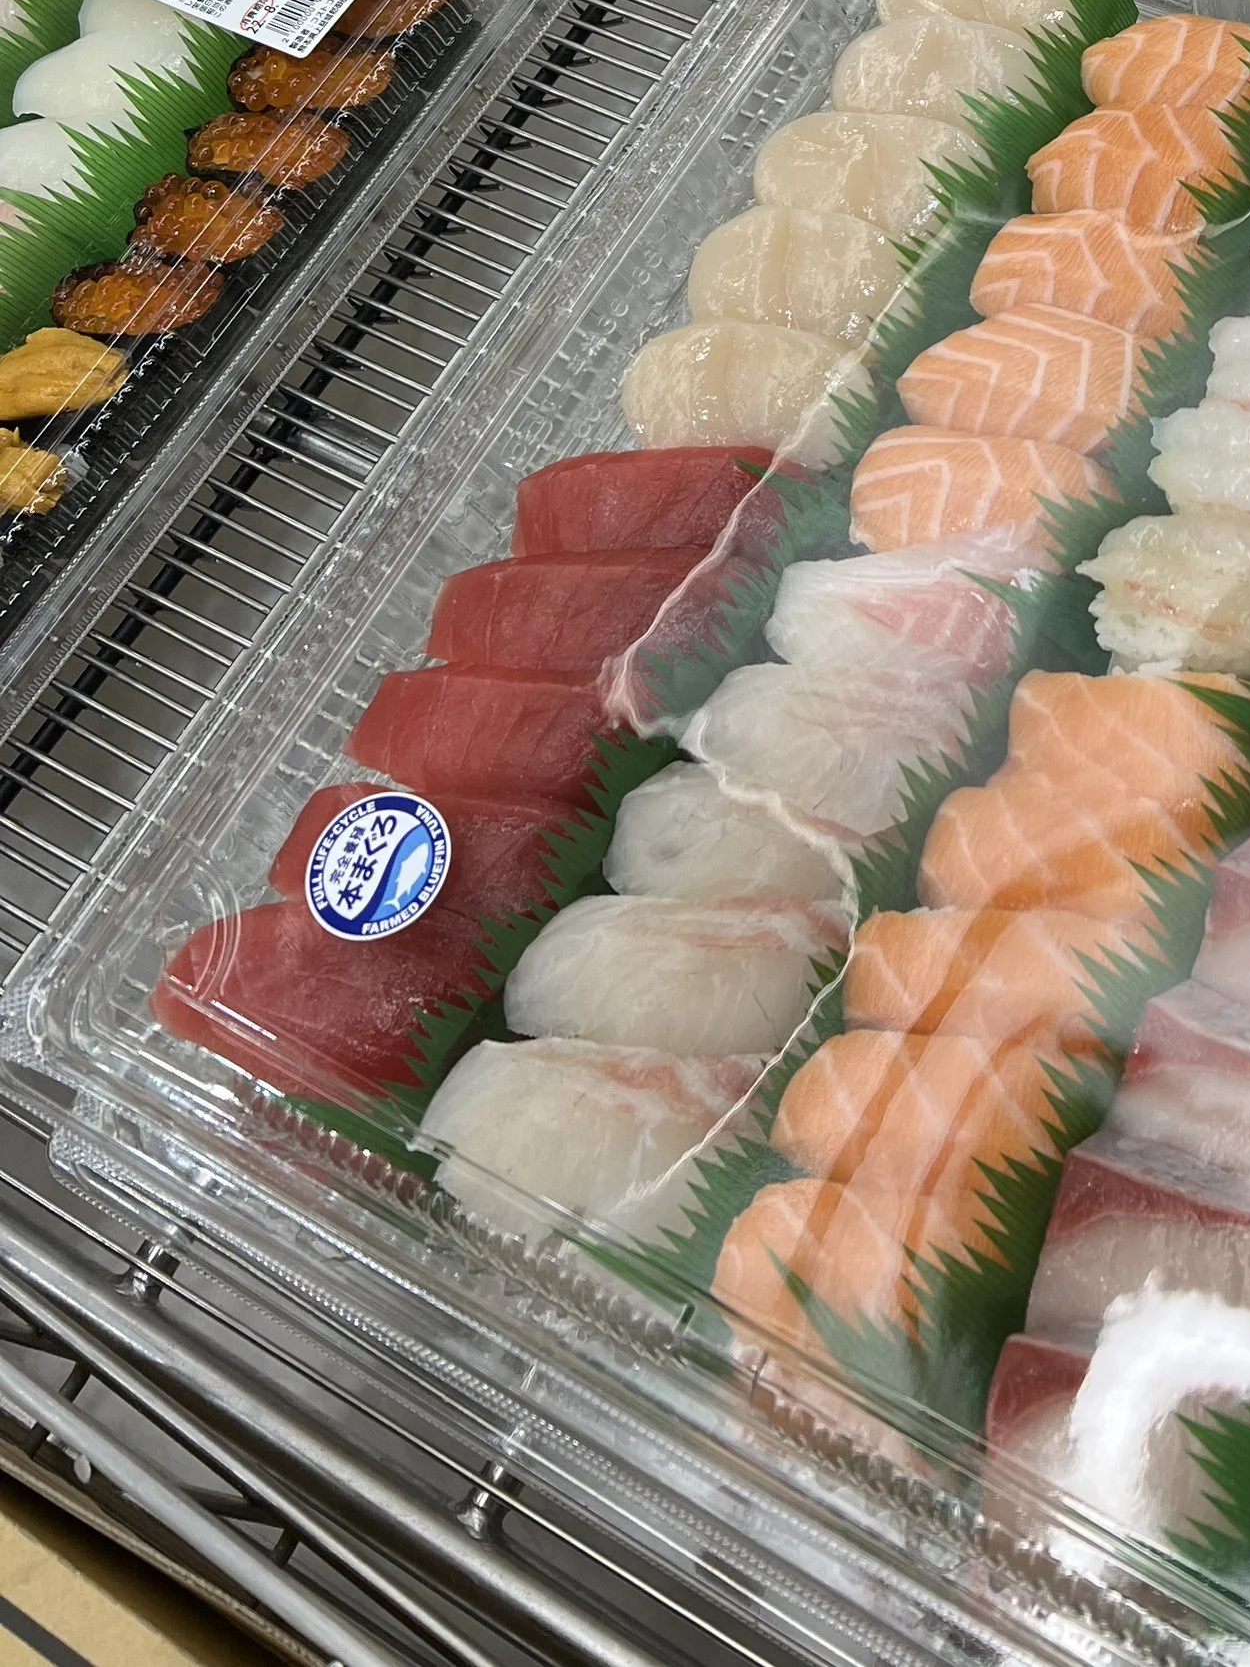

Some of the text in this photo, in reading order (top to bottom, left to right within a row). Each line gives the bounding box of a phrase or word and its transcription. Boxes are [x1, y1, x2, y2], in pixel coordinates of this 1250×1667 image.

[245, 16, 266, 34] 22.
[262, 1, 279, 13] 8.
[330, 825, 366, 884] 完全養殖
[337, 814, 398, 910] 本まぐろ
[362, 804, 447, 935] FARMED BLUEFIN TUNA
[311, 873, 328, 910] FULL
